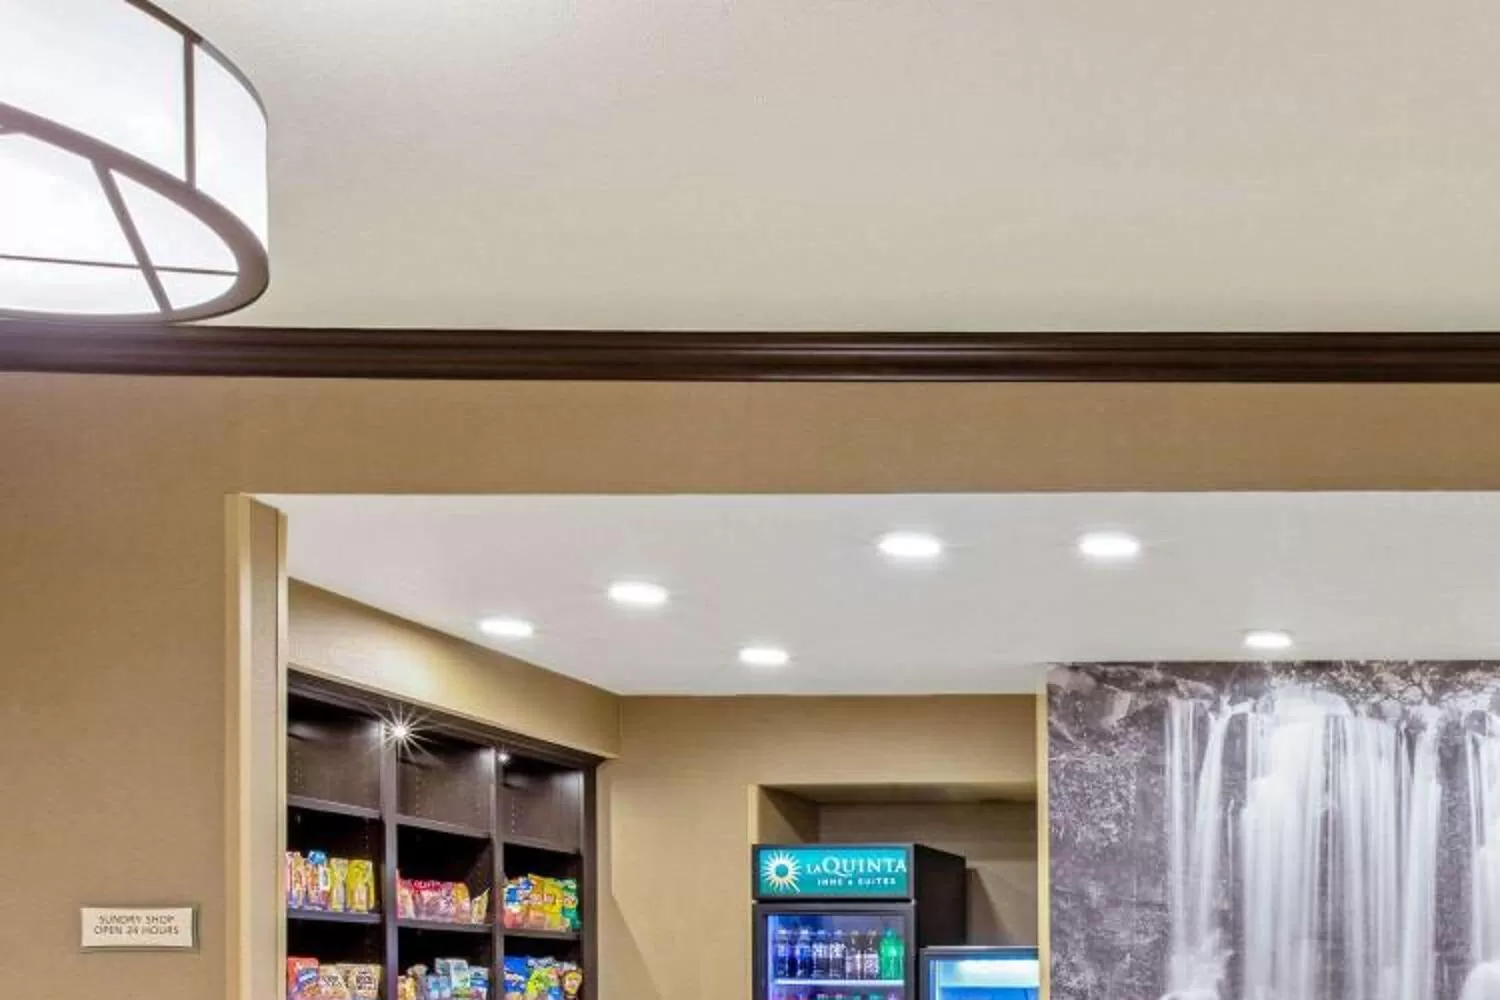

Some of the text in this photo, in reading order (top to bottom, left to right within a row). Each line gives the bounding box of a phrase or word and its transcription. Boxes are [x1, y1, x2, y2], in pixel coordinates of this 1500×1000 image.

[145, 915, 175, 925] SHOP
[94, 925, 123, 935] OPEN
[141, 925, 179, 935] HOURS
